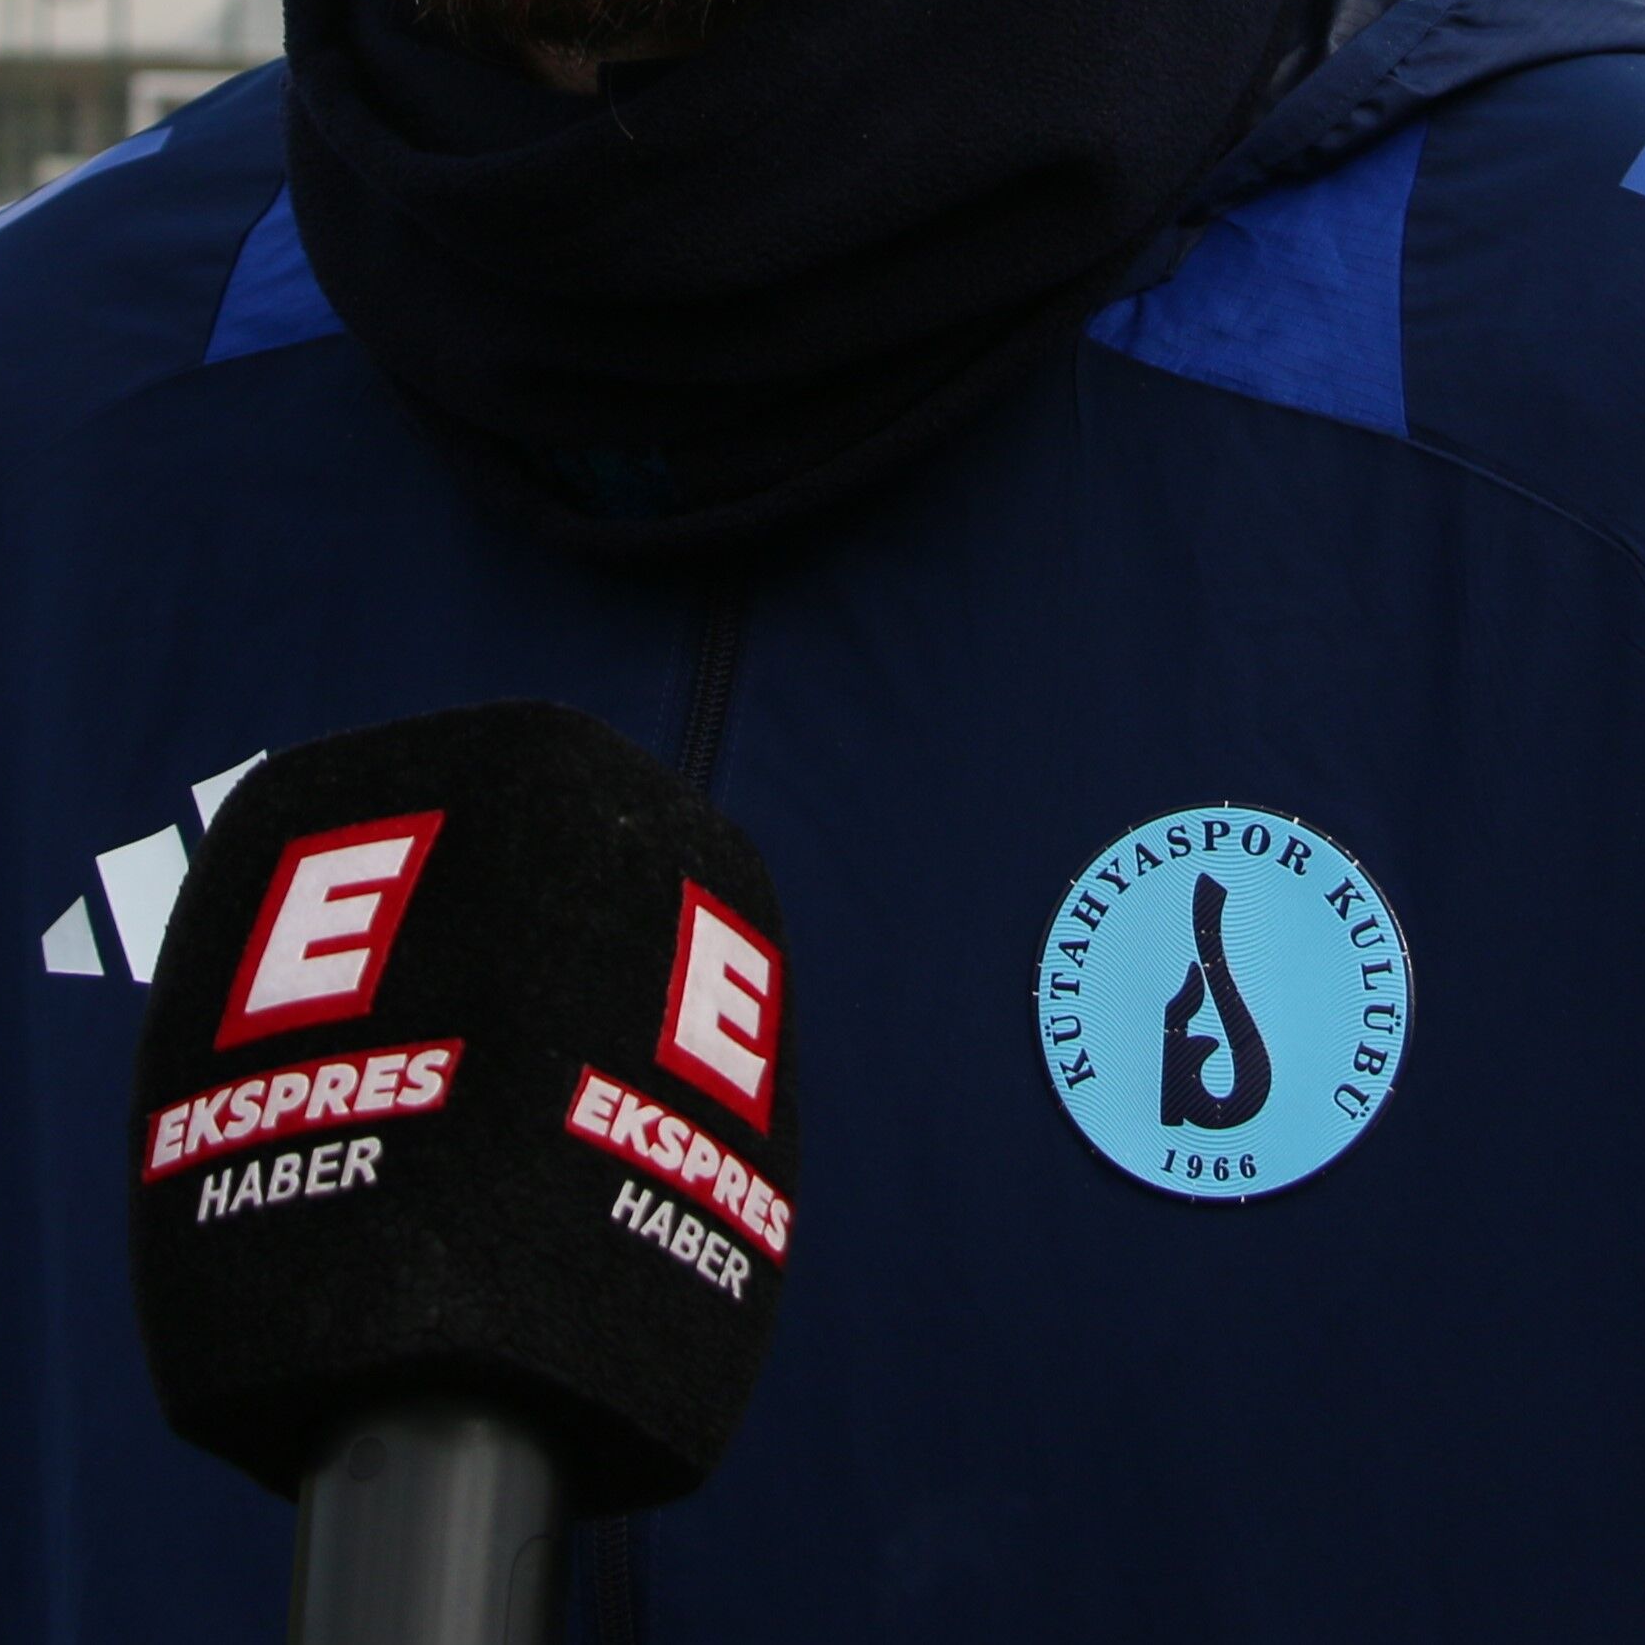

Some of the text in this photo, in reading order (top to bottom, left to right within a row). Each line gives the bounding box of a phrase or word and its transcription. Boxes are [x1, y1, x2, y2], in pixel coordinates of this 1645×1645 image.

[244, 835, 414, 1014] E
[1045, 819, 1402, 1120] KÜTAHYASPOR KULÜBÜ
[672, 904, 770, 1100] E
[149, 1048, 450, 1169] EKSPRES
[196, 1136, 383, 1224] HABER
[570, 1078, 790, 1256] EKSPRES
[1159, 1149, 1257, 1181] 1966
[610, 1180, 750, 1299] HABER
